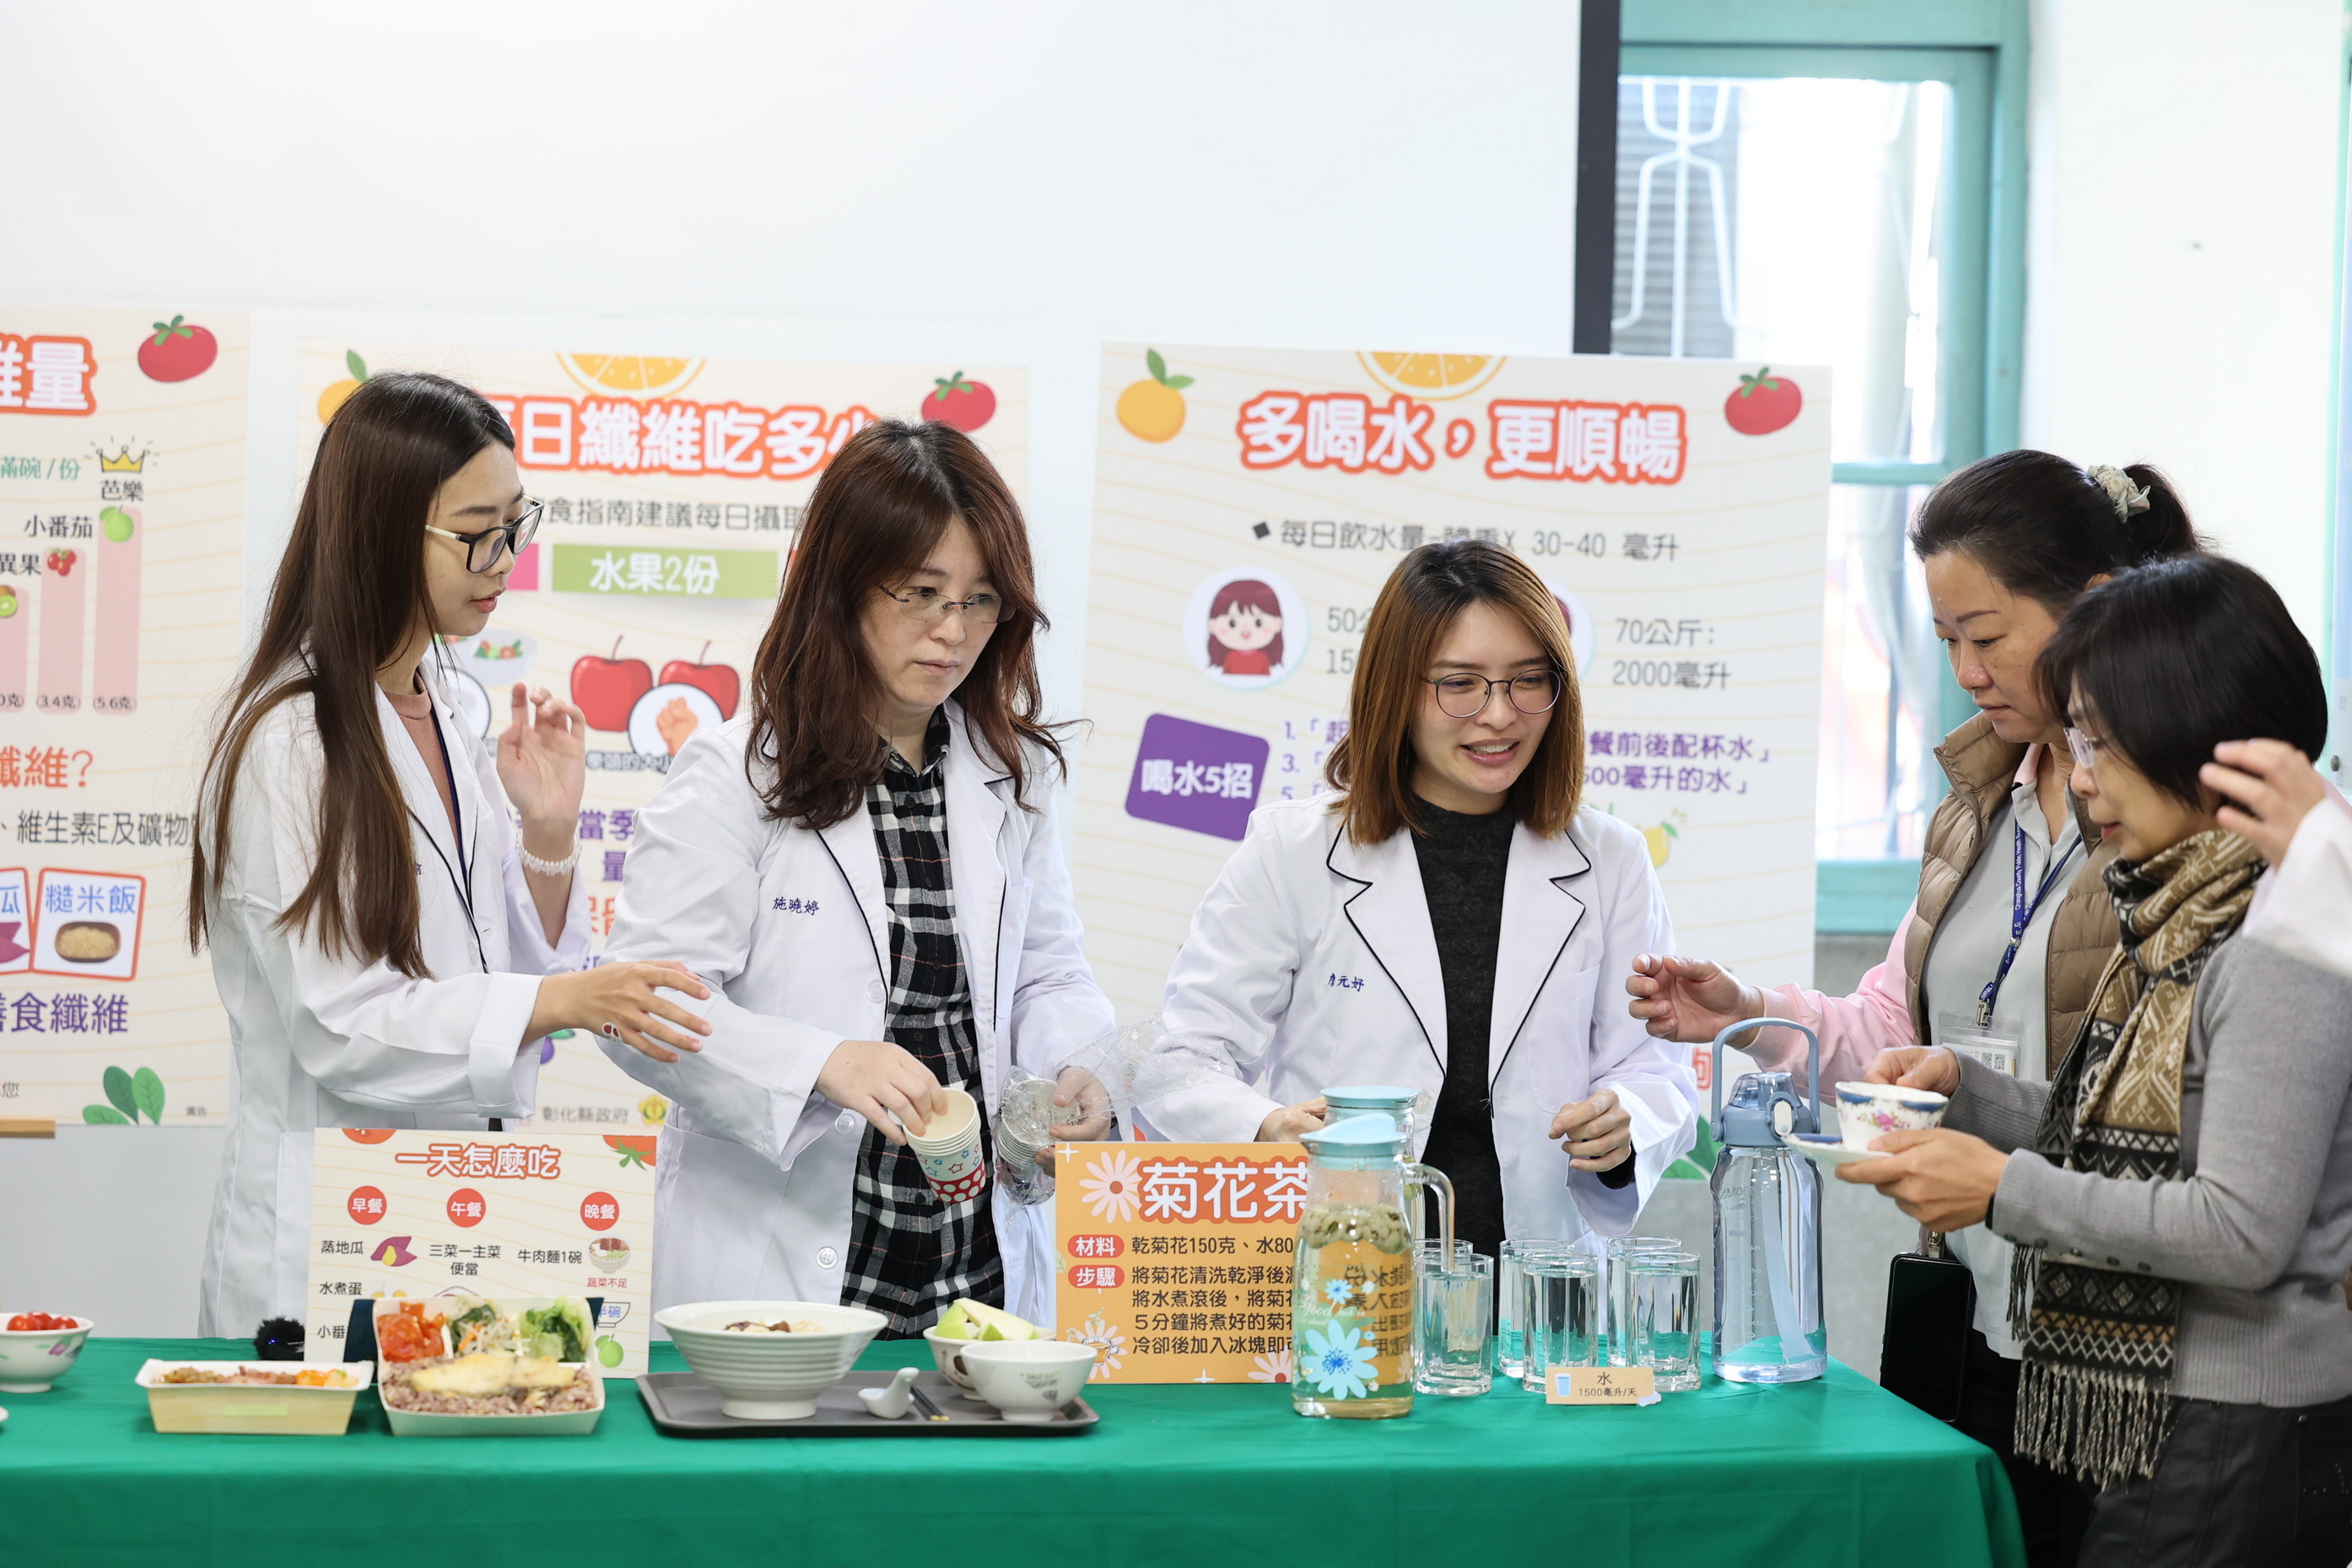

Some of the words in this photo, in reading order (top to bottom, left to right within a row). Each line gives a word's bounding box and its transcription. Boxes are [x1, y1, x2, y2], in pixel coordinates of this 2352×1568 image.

[501, 400, 876, 476] 日纖維吃多
[1240, 395, 1683, 481] 多喝水，更順暢
[100, 481, 144, 503] 芭樂
[537, 496, 801, 531] 食指南建議每日攝
[24, 515, 94, 540] 小番茄
[1532, 531, 1606, 558] 30-40
[1622, 533, 1680, 563] 毫升
[591, 552, 720, 595] 水果2份
[1612, 660, 1732, 691] 2000毫升
[1141, 758, 1254, 800] 喝水5招
[2015, 870, 2023, 886] County
[46, 884, 137, 914] 糙米飯
[772, 896, 820, 916] 施曉婷
[2015, 886, 2023, 911] Changhua
[0, 992, 129, 1035] 食纖維
[542, 1105, 629, 1124] 彰化縣政府
[396, 1143, 560, 1178] 一天怎麼吃
[1141, 1161, 1308, 1220] 菊花茶
[351, 1197, 383, 1215] 早餐
[450, 1201, 483, 1218] 午餐
[584, 1203, 616, 1220] 晚餐
[321, 1240, 364, 1256] 蒸地瓜
[429, 1245, 502, 1260] 三菜一主菜
[1076, 1237, 1116, 1257] 材料
[1131, 1237, 1294, 1255] 乾菊花150克、水80
[517, 1248, 583, 1265] 牛肉麵1碗
[450, 1261, 479, 1276] 便當
[1076, 1266, 1116, 1287] 步驟
[319, 1281, 363, 1296] 水煮蛋
[586, 1277, 628, 1289] 蔬菜不足
[1597, 1371, 1613, 1386] 水
[1578, 1387, 1637, 1398] 1500毫升/天
